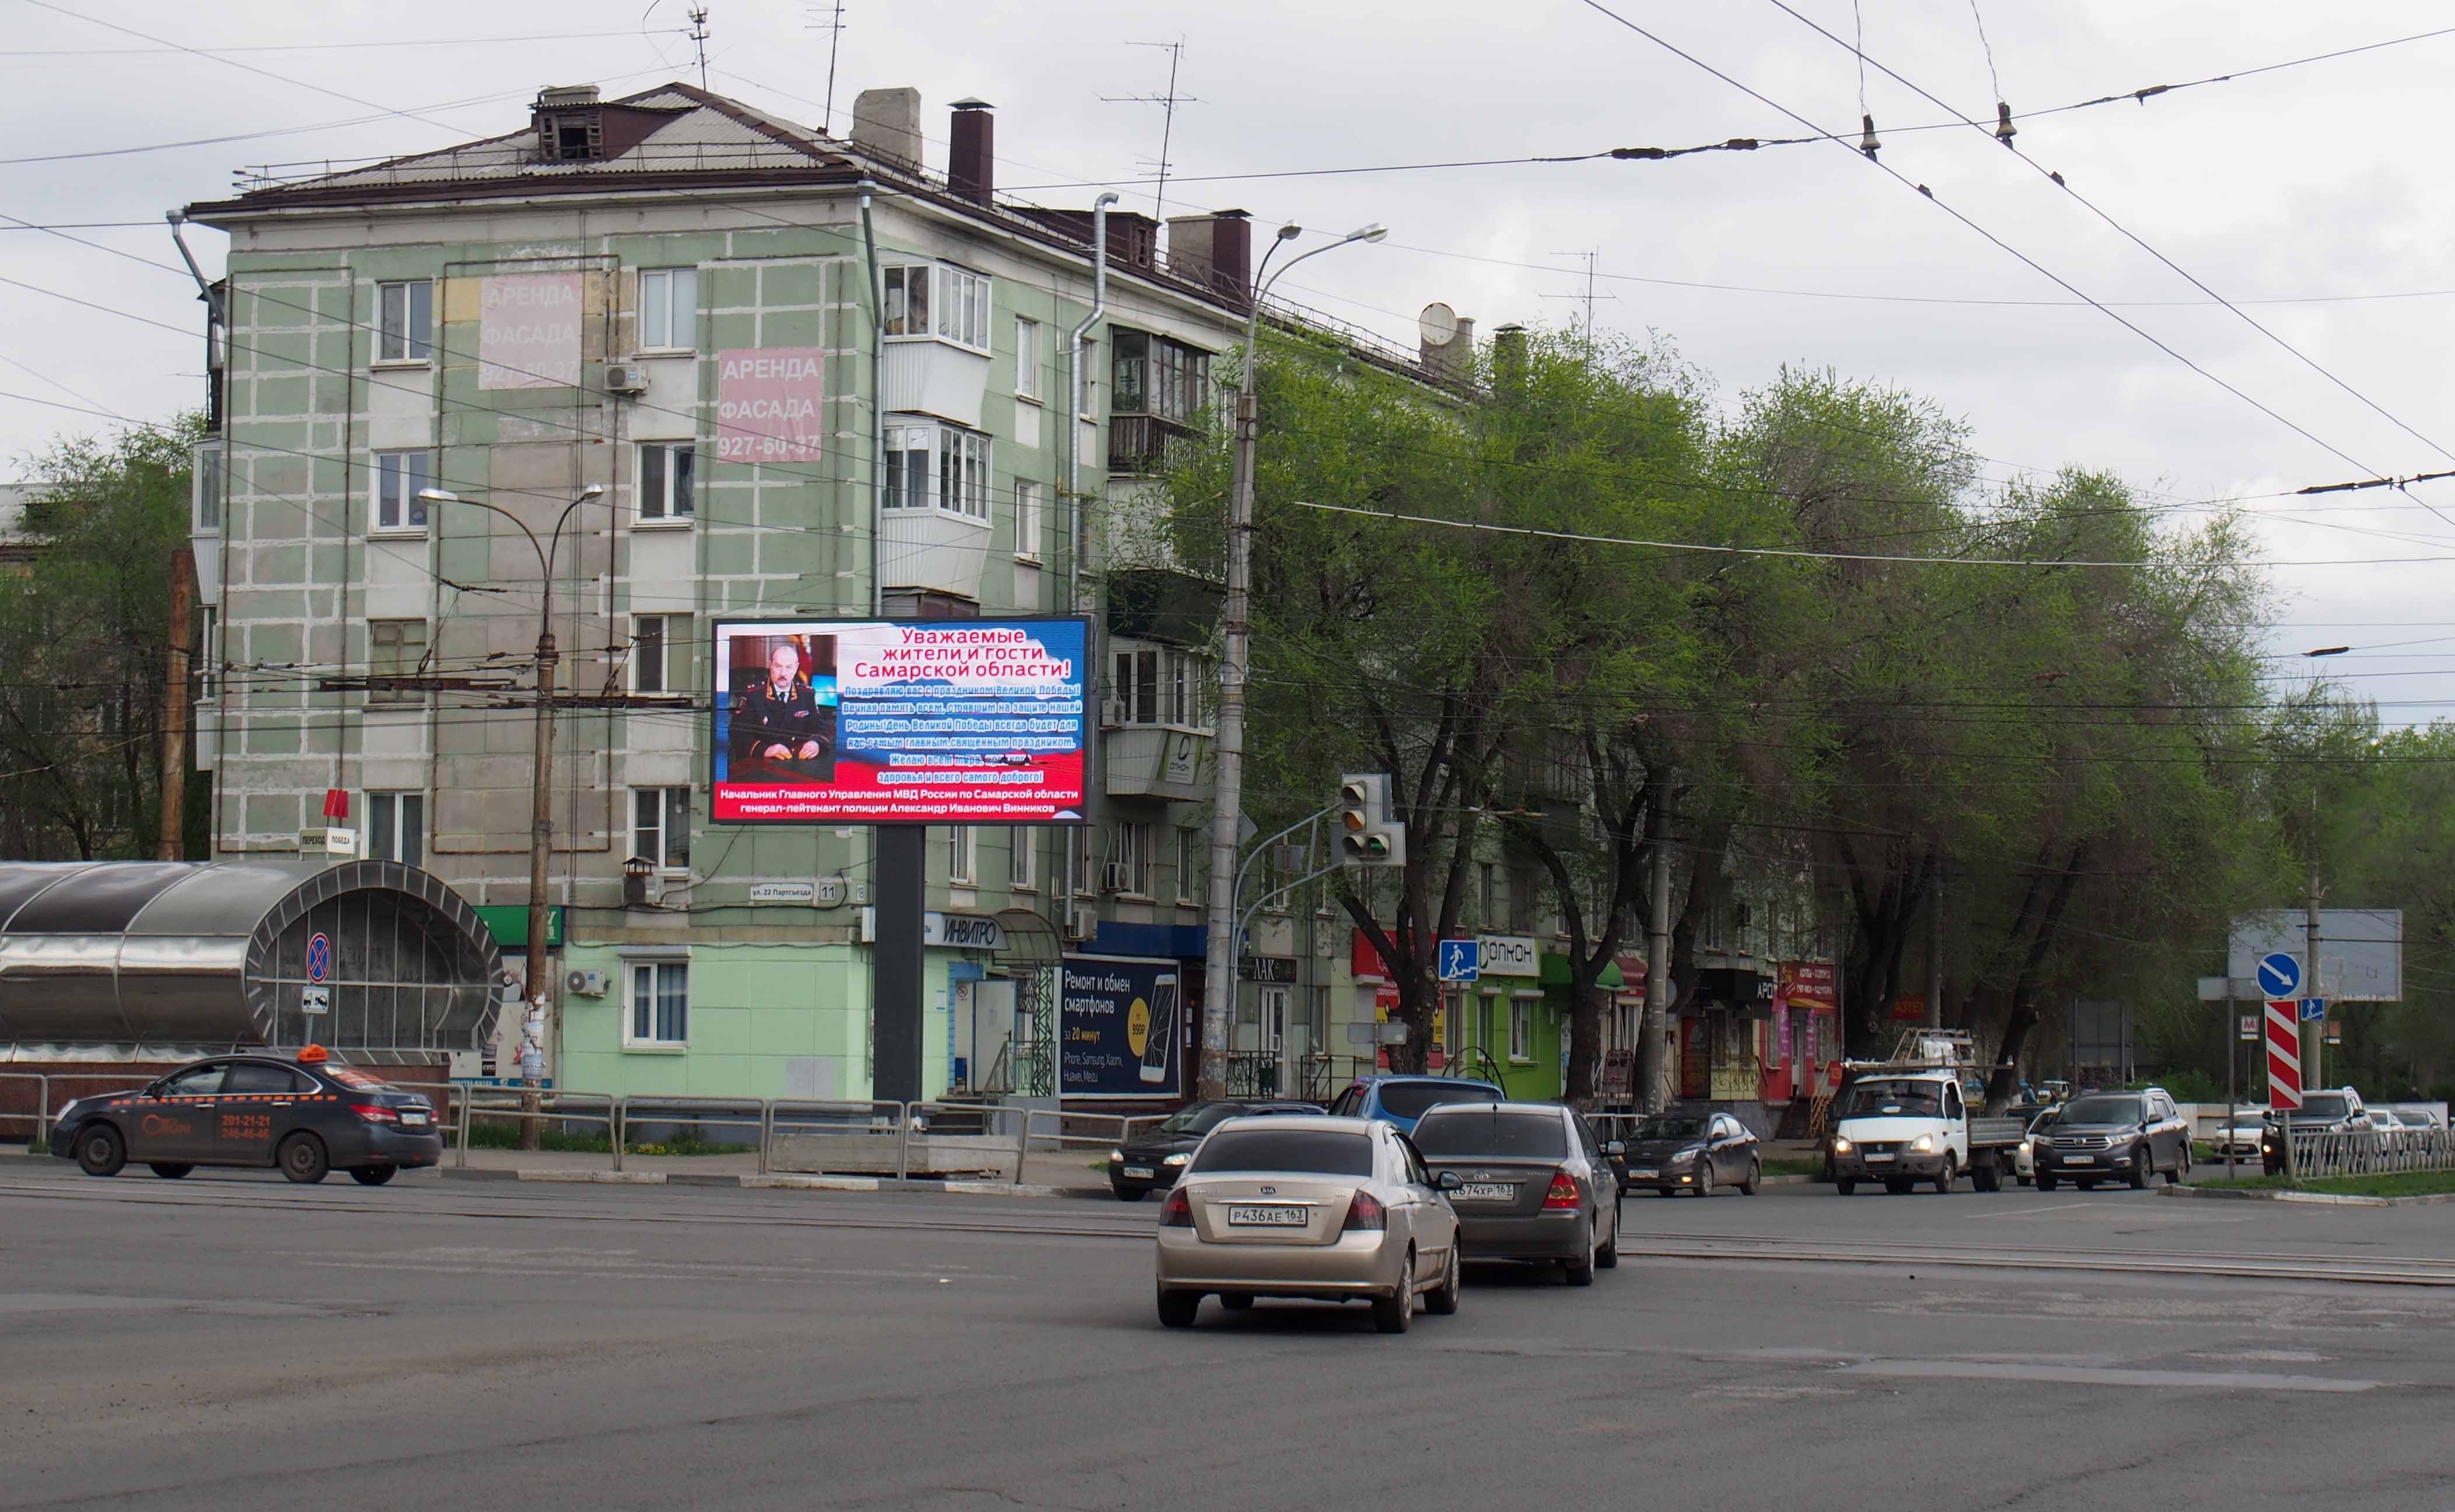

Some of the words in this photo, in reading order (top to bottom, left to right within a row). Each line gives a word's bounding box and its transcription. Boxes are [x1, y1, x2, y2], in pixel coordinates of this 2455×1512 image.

[488, 285, 574, 308] АРЕНДА
[486, 324, 574, 348] ФАСАДА
[723, 358, 819, 382] АРЕНДА
[719, 398, 814, 421] ФАСАДА
[719, 435, 820, 456] 927-60-37
[902, 629, 1024, 643] Уважаемые
[883, 649, 961, 660] жители
[968, 648, 978, 660] и
[986, 648, 1042, 660] гости
[855, 660, 969, 680] Самарской
[976, 662, 1069, 676] области!
[846, 687, 903, 696] Поздравляю
[907, 687, 923, 695] вас
[935, 686, 993, 695] праздником
[996, 685, 1036, 694] Великой
[1040, 684, 1080, 694] Победы!
[844, 704, 876, 713] Вечная
[880, 704, 915, 712] память
[918, 704, 946, 713] всем,
[949, 703, 995, 712] стоявшим
[999, 704, 1010, 712] на
[1013, 703, 1047, 713] защите
[1050, 702, 1082, 712] нашей
[914, 719, 952, 729] Великой
[956, 719, 992, 730] Победы
[995, 720, 1027, 730] всегда
[1030, 719, 1057, 730] будет
[1059, 720, 1077, 730] для
[848, 738, 865, 747] вас
[868, 738, 903, 747] самым
[1012, 738, 1075, 748] праздником.
[891, 755, 924, 765] Желаю
[928, 755, 953, 764] всем
[879, 772, 923, 783] здоровья
[926, 773, 932, 782] и
[935, 773, 960, 782] всего
[963, 773, 998, 782] самого
[1001, 772, 1043, 783] доброго!
[721, 790, 777, 799] Начальник
[779, 790, 827, 799] Главного
[829, 790, 891, 800] Управления
[894, 790, 918, 800] МВД
[921, 790, 957, 799] России
[974, 789, 1032, 800] Самарской
[1035, 789, 1078, 799] области
[740, 804, 840, 813] генерал-лейтенант
[842, 805, 887, 813] полиции
[890, 803, 947, 813] Александр
[950, 804, 1001, 813] Иванович
[1003, 803, 1055, 813] Винников
[302, 835, 325, 845] ПЕРЕХОД
[821, 886, 834, 898] 11
[943, 919, 996, 944] ИНВИТРО
[1065, 970, 1096, 990] Ремонт
[1097, 977, 1103, 991] и
[1104, 972, 1130, 992] обмен
[1065, 993, 1114, 1018] смартфонов
[1065, 1031, 1071, 1040] за
[1072, 1027, 1080, 1041] 20
[1082, 1031, 1101, 1045] минут
[1064, 1052, 1082, 1066] iPhone,
[1082, 1052, 1105, 1069] Samsung,
[1083, 1070, 1098, 1083] Meizu
[222, 1115, 270, 1126] 201-21-21
[1496, 1184, 1512, 1194] 163
[1233, 1209, 1282, 1223] Р436АЕ
[1285, 1209, 1303, 1220] 163
